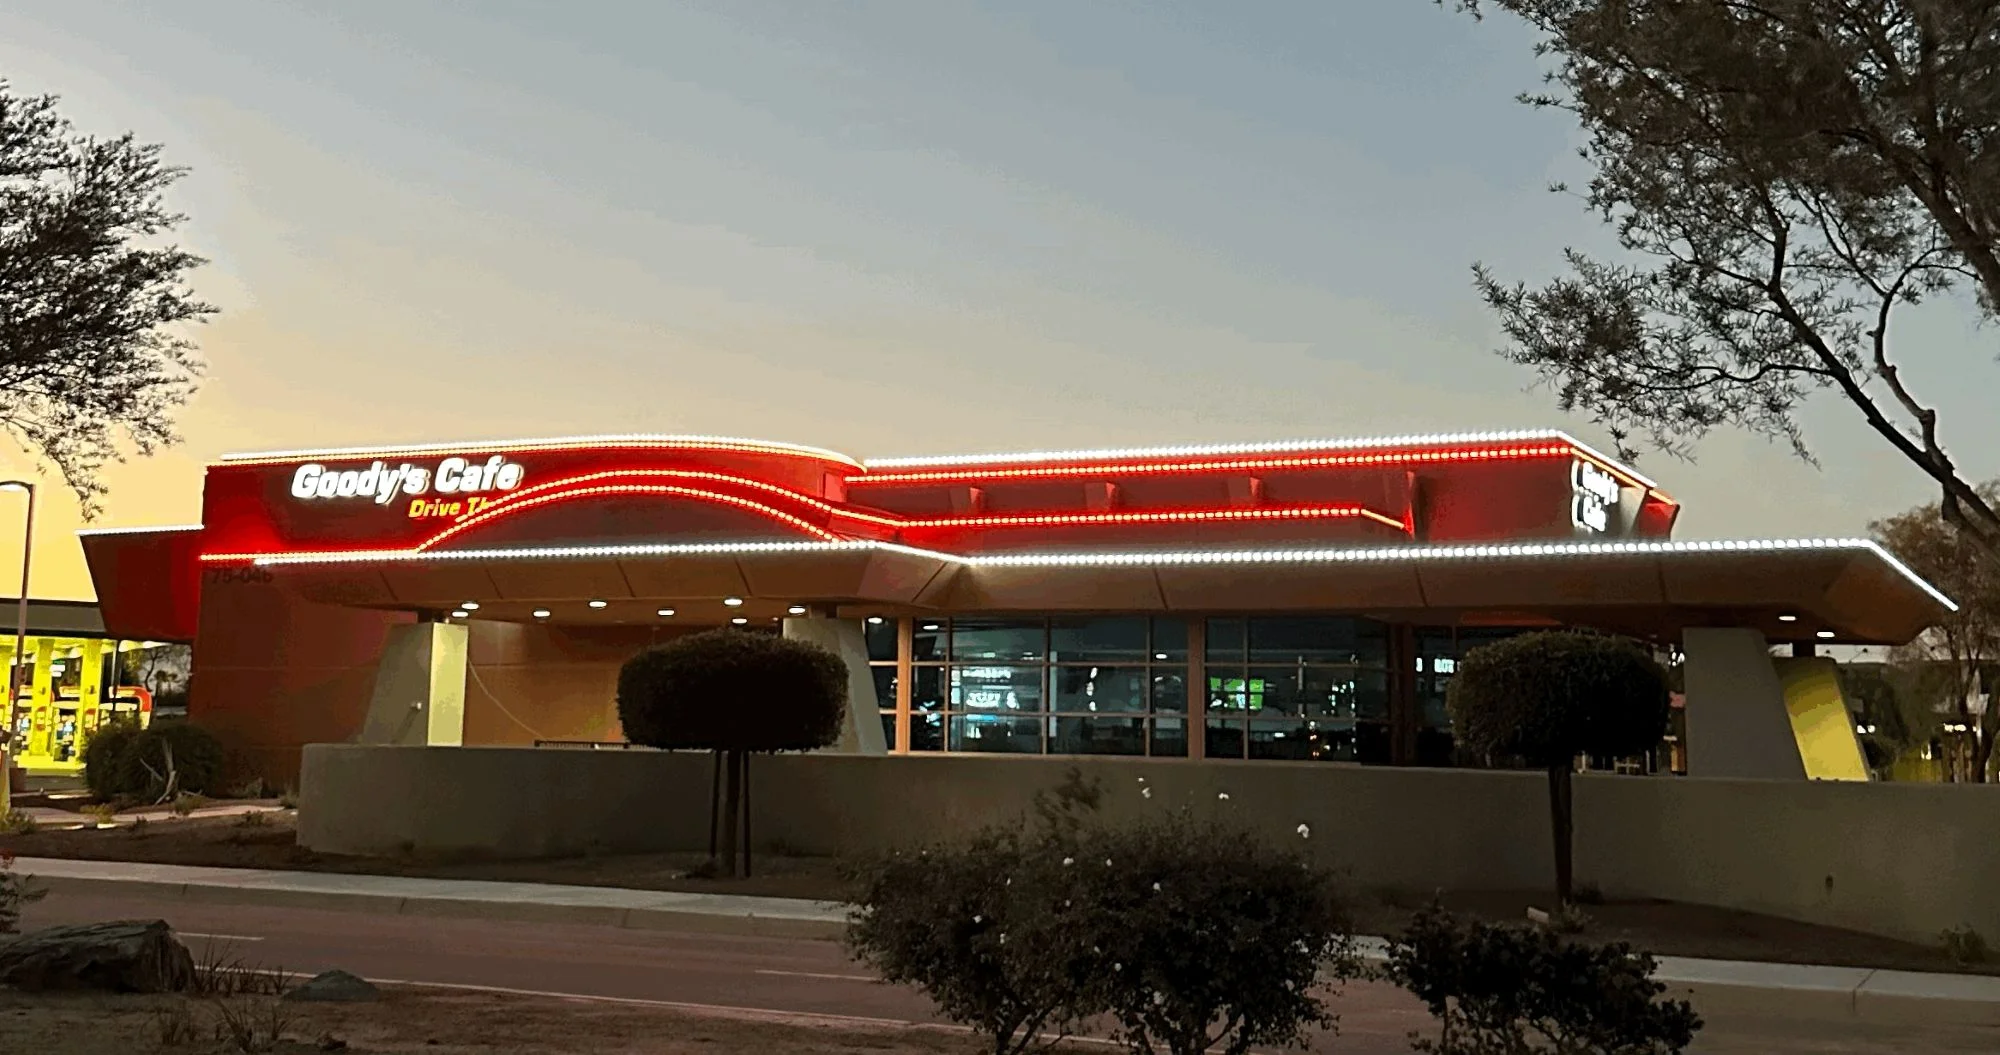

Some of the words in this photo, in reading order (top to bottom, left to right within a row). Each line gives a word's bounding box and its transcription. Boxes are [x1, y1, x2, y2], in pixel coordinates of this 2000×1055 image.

[291, 461, 431, 504] Goody's
[434, 455, 524, 492] Cafe
[408, 498, 461, 518] Drive
